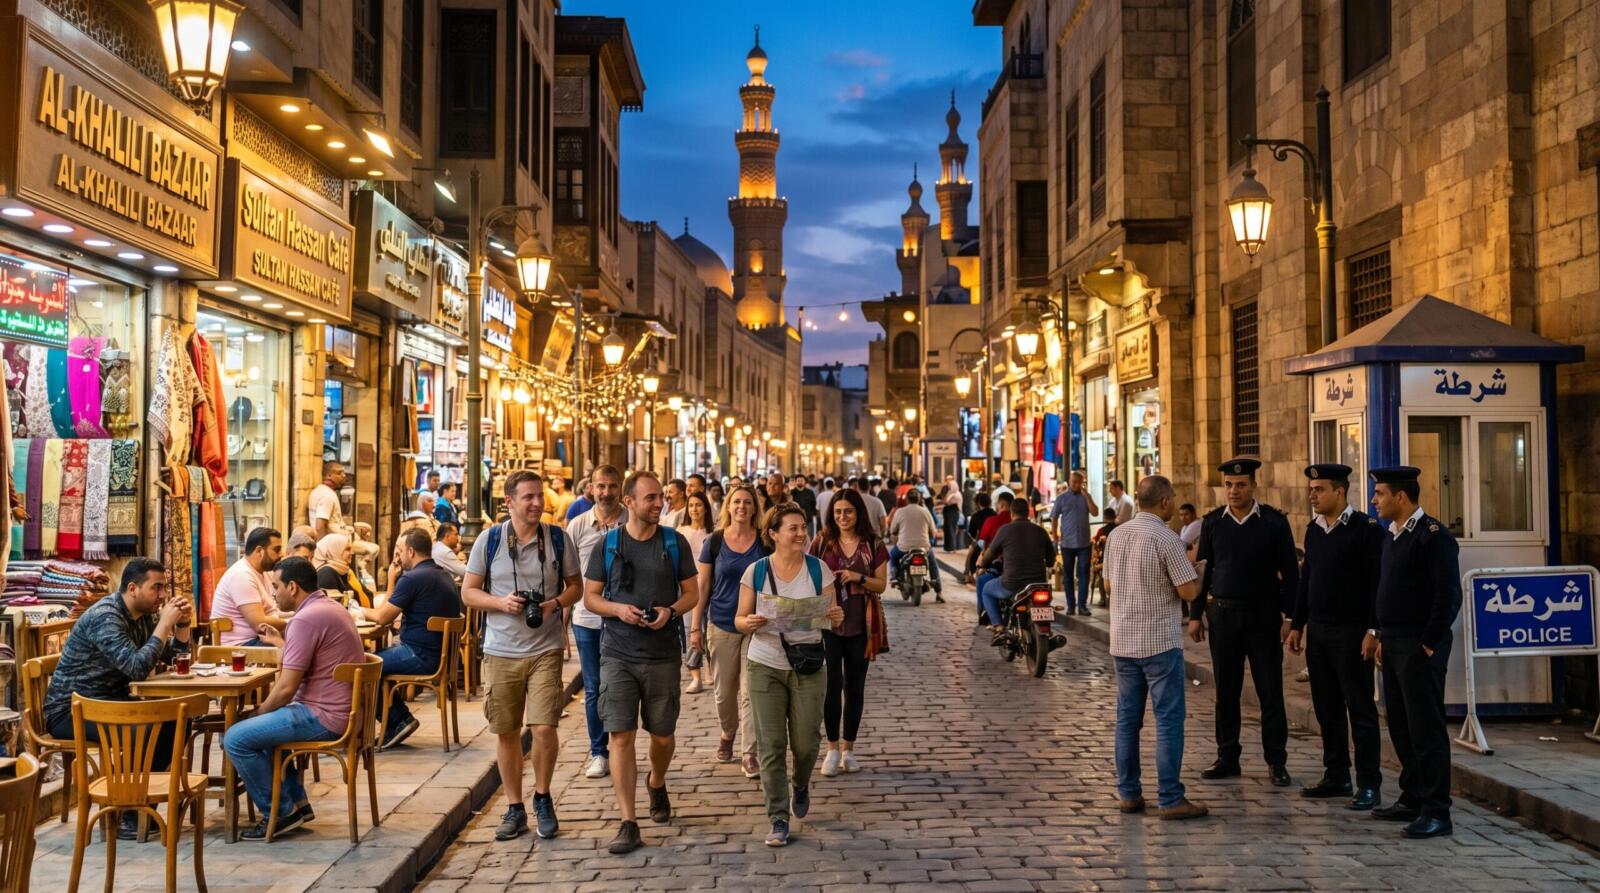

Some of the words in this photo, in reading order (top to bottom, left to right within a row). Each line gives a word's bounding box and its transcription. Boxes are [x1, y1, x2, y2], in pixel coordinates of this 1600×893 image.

[38, 66, 147, 175] AL-KHALILI
[148, 131, 211, 210] BAZAAR
[55, 153, 143, 222] AL-KHALILI
[145, 196, 198, 246] BAZAAR
[242, 184, 285, 242] Sultan
[286, 208, 326, 262] Hassan
[253, 249, 287, 284] SULTAN
[288, 264, 320, 297] HASSAN
[1325, 373, 1354, 406] شرطة
[1434, 368, 1507, 403] شرطة
[1482, 580, 1583, 621] شرطة
[1499, 627, 1572, 644] POLICE
